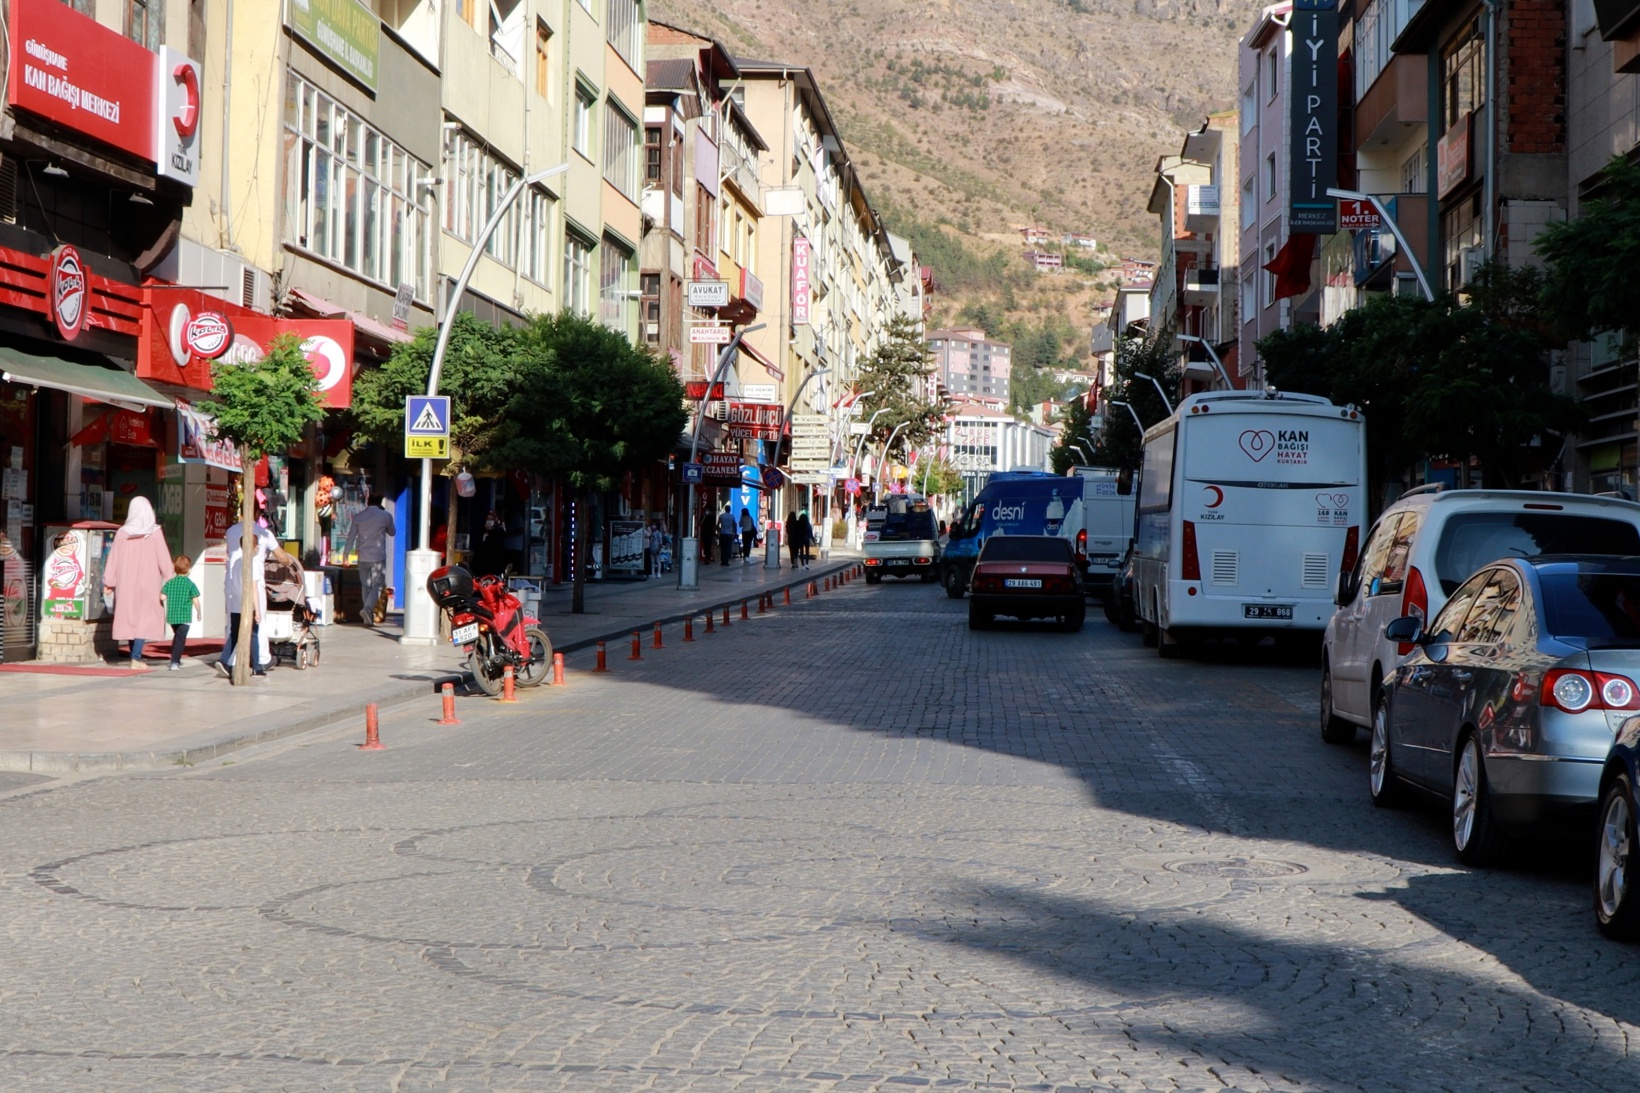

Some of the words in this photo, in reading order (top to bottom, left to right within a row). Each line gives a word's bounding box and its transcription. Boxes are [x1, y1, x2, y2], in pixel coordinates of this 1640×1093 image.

[25, 39, 68, 71] GÜMÜŞHANE
[25, 64, 46, 92] KAN
[48, 74, 79, 110] BAĞIŞI
[81, 91, 120, 124] MERKEZİ
[171, 152, 193, 175] KIZILAY
[1352, 202, 1369, 215] 1.
[796, 245, 807, 317] KUAFÖR
[731, 405, 783, 426] GÖZLÜKÇÜ
[730, 427, 754, 438] YÜCEL
[1278, 430, 1309, 442] KAN
[412, 439, 433, 447] İLK
[1278, 442, 1308, 452] BAĞIŞI
[703, 465, 738, 474] ECZANESİ
[992, 500, 1025, 520] desni
[214, 512, 226, 527] GSM
[463, 625, 477, 633] AFA
[459, 632, 473, 640] 920
